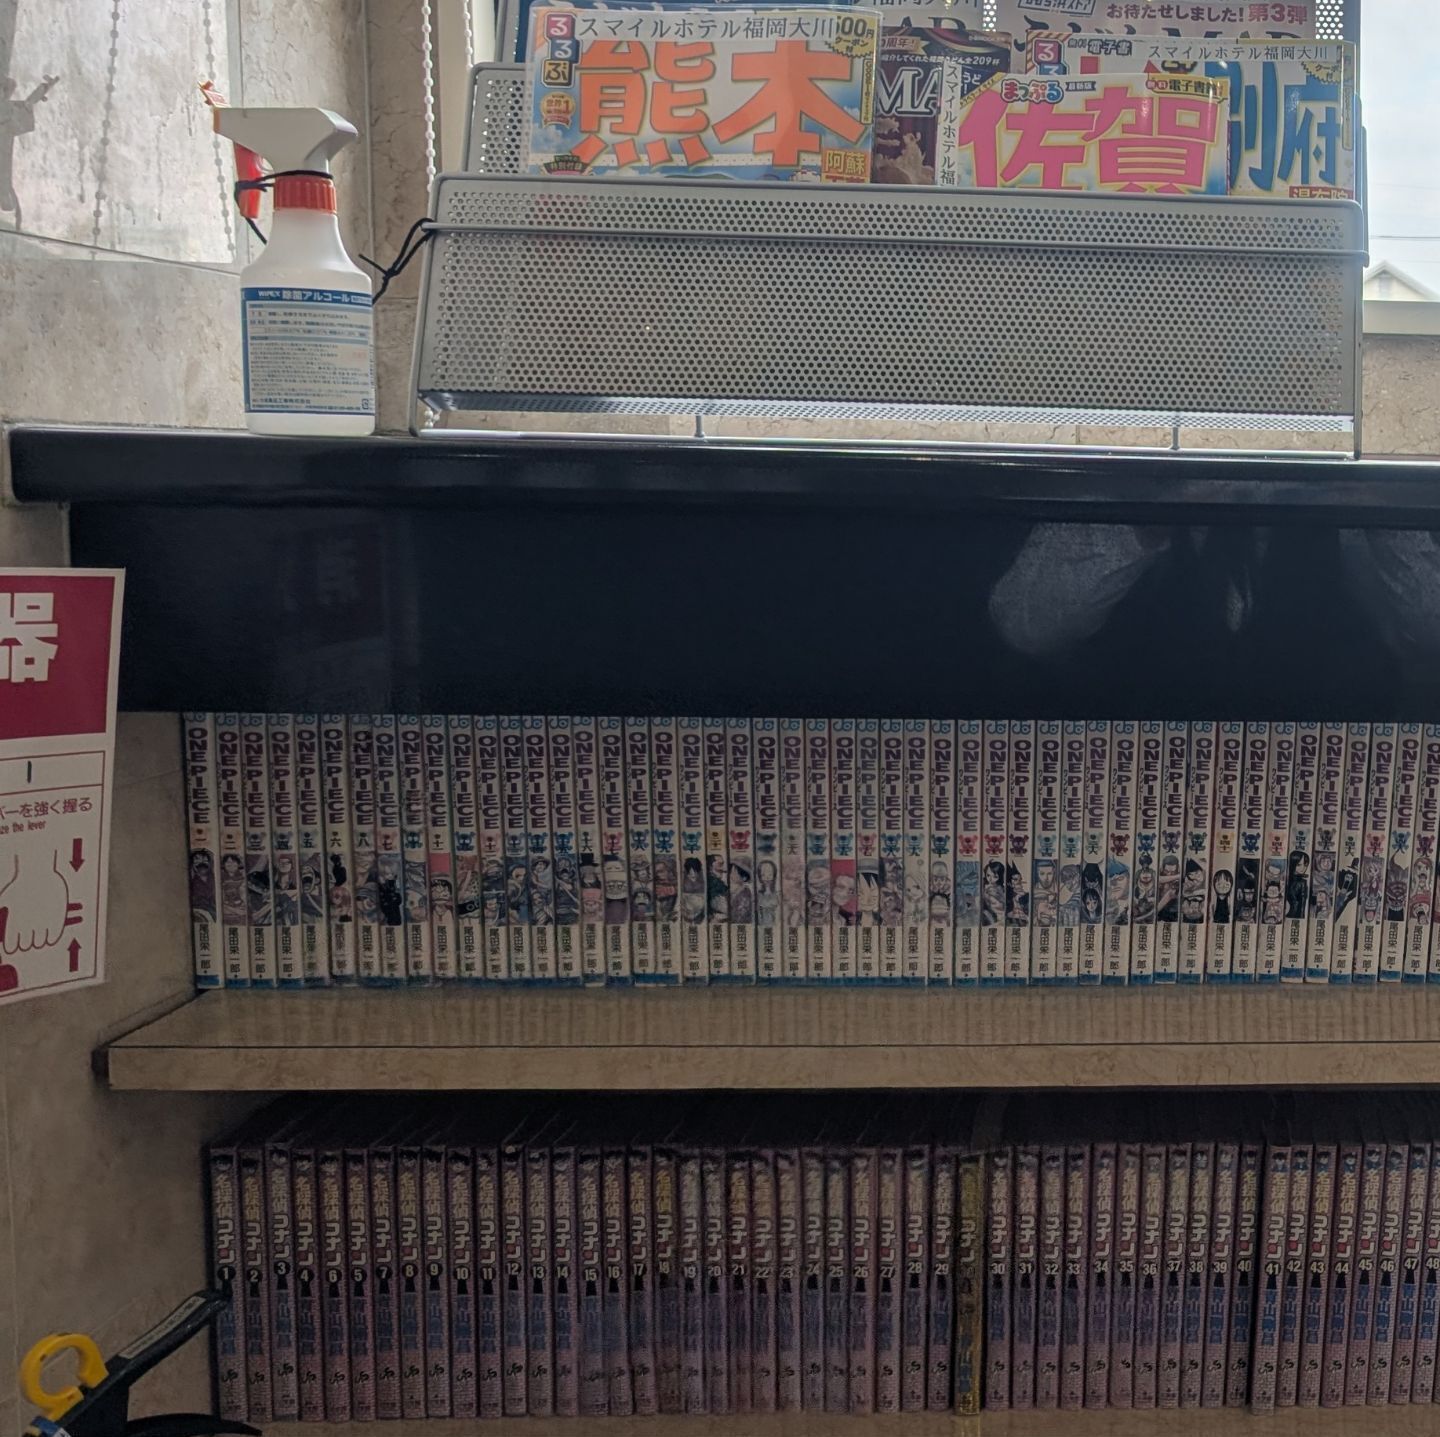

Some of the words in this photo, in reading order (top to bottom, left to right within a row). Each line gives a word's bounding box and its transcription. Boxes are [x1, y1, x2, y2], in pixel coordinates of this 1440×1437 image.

[579, 16, 833, 40] スマイルホテル福岡大川
[1249, 3, 1308, 24] 第3弾
[545, 15, 574, 83] るるぶ
[1149, 45, 1328, 61] スマイルホテル福岡大川
[569, 40, 869, 168] 熊本
[1001, 79, 1063, 103] まっぷる
[959, 87, 1218, 193] 佐賀
[189, 728, 207, 763] ONE
[218, 732, 238, 766] ONE
[271, 732, 290, 766] ONE
[323, 729, 343, 764] ONE
[731, 734, 749, 766] ONE
[934, 738, 953, 771] ONE
[1042, 740, 1059, 772] ONE
[1169, 736, 1186, 770] ONE
[1248, 740, 1266, 772] ONE
[1402, 739, 1419, 771] ONE
[191, 766, 210, 823] PIECE
[222, 768, 240, 827] PIECE
[274, 768, 293, 827] PIECE
[326, 766, 345, 824] PIECE
[731, 770, 749, 827] PIECE
[934, 775, 951, 830] PIECE
[1042, 775, 1058, 831] PIECE
[1167, 773, 1184, 827] PIECE
[1246, 775, 1264, 829] PIECE
[1398, 774, 1417, 828] PIECE
[223, 1268, 229, 1279] 1
[354, 1270, 362, 1281] 5
[430, 1264, 438, 1276] 9
[482, 1268, 493, 1280] 11
[532, 1266, 544, 1279] 13
[633, 1264, 644, 1277] 17
[733, 1263, 744, 1275] 21
[908, 1262, 921, 1275] 28
[1095, 1260, 1108, 1273] 34
[1238, 1259, 1252, 1272] 40
[1335, 1261, 1349, 1274] 44
